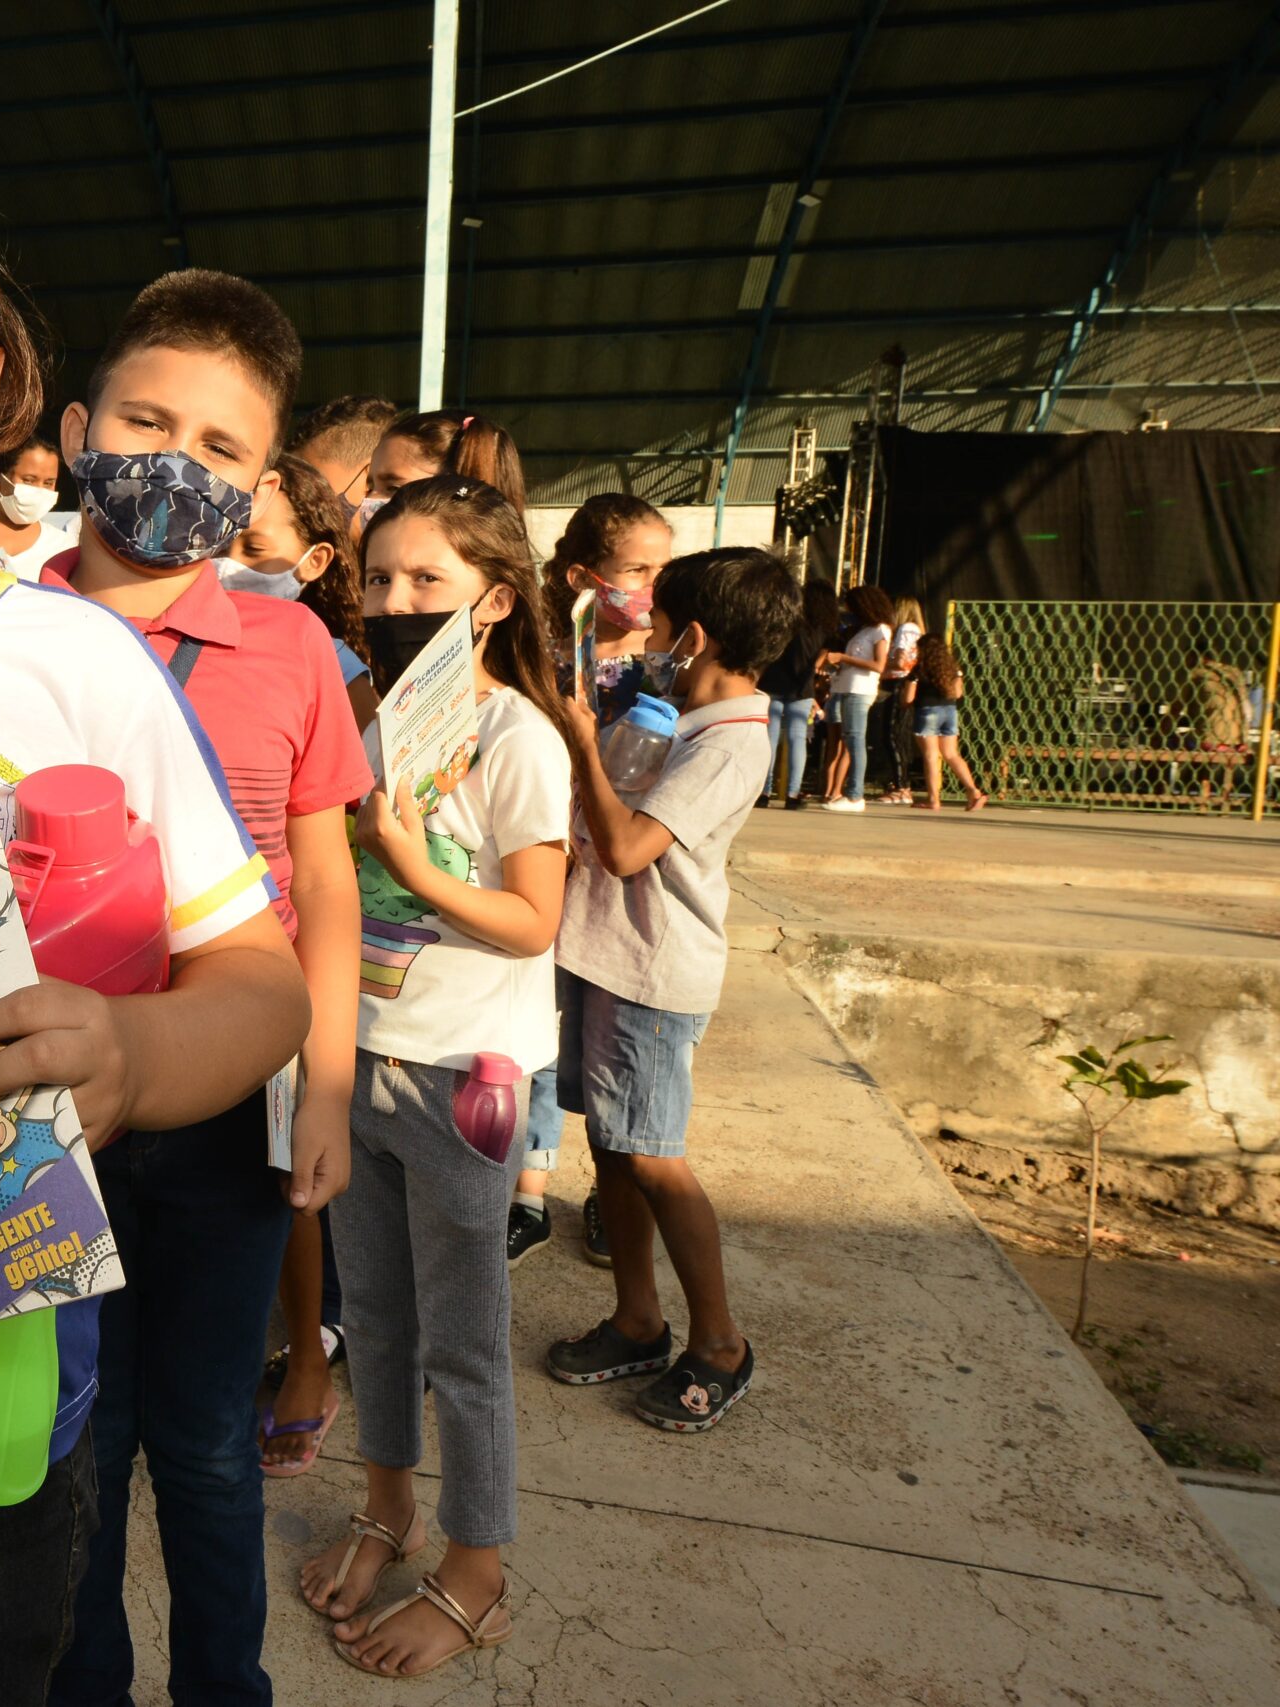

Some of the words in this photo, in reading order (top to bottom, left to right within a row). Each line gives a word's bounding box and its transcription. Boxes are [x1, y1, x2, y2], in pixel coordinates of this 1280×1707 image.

[416, 645, 455, 687] ACADEMIA
[4, 1231, 86, 1290] gente!
[11, 1243, 33, 1261] com
[32, 1239, 42, 1251] a
